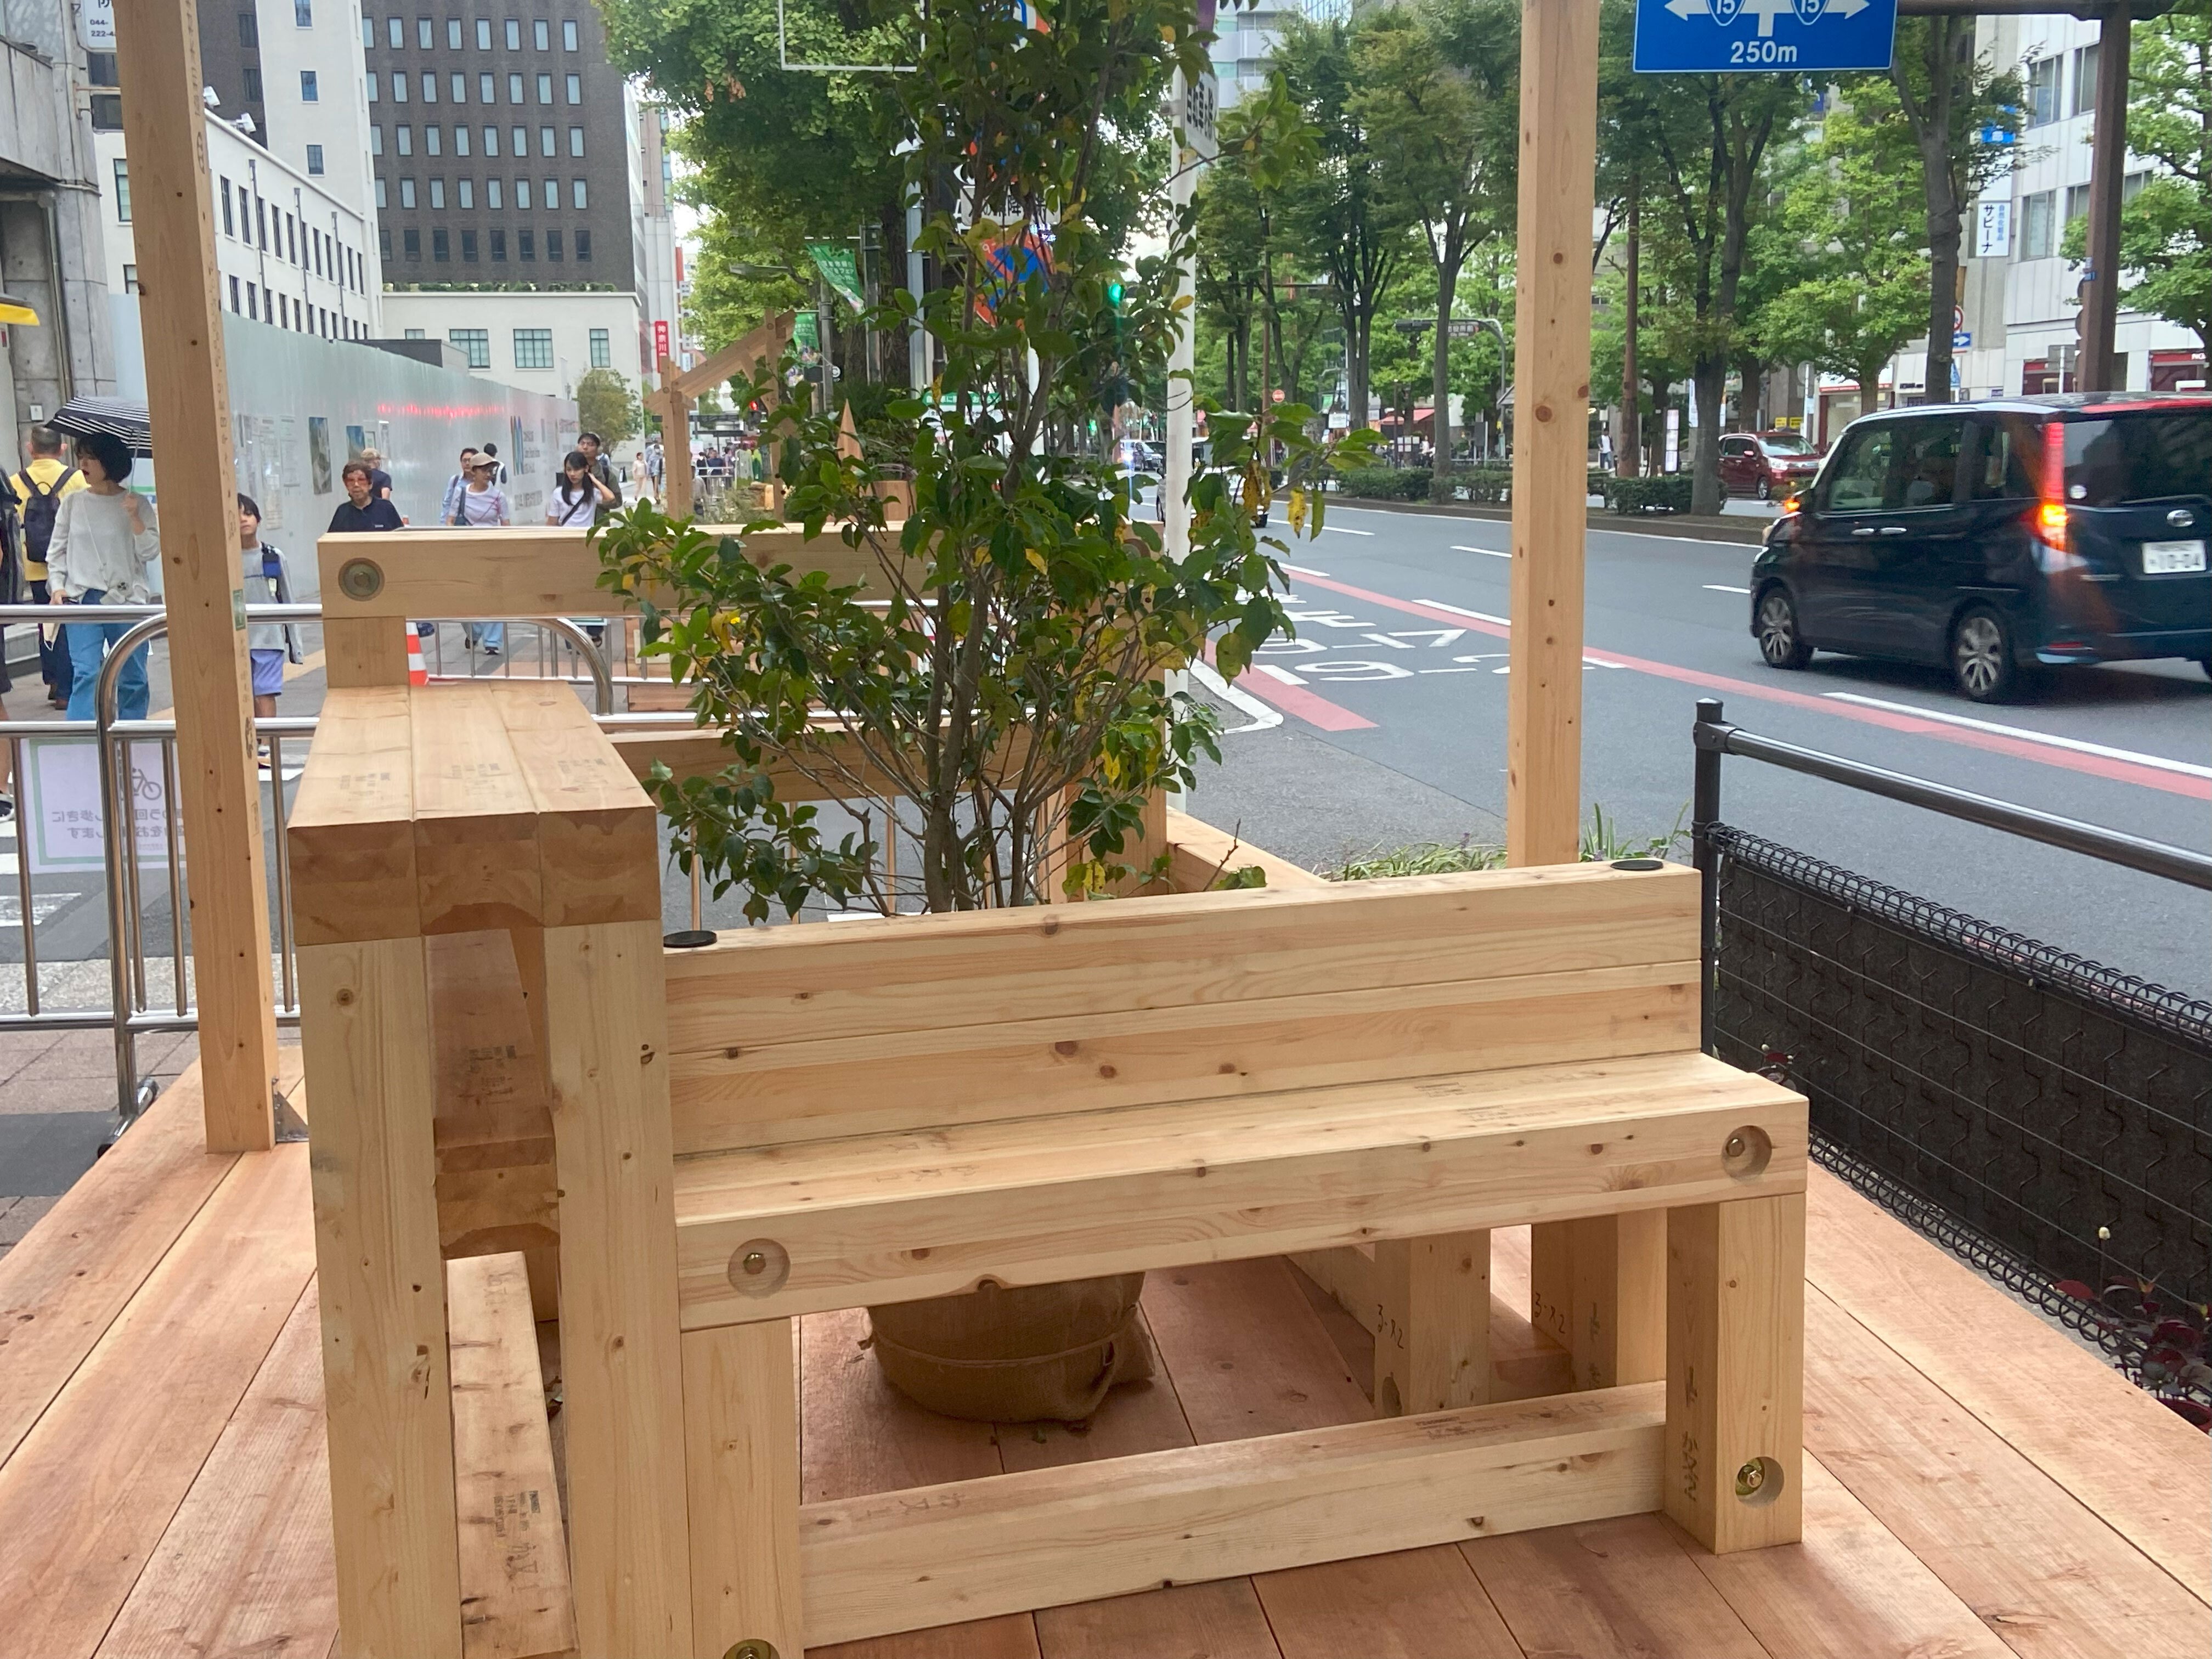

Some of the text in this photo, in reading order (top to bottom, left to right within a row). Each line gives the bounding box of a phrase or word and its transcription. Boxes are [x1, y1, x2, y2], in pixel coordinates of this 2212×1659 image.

[1730, 41, 1797, 63] 250m
[1982, 205, 1995, 253] サビーナ
